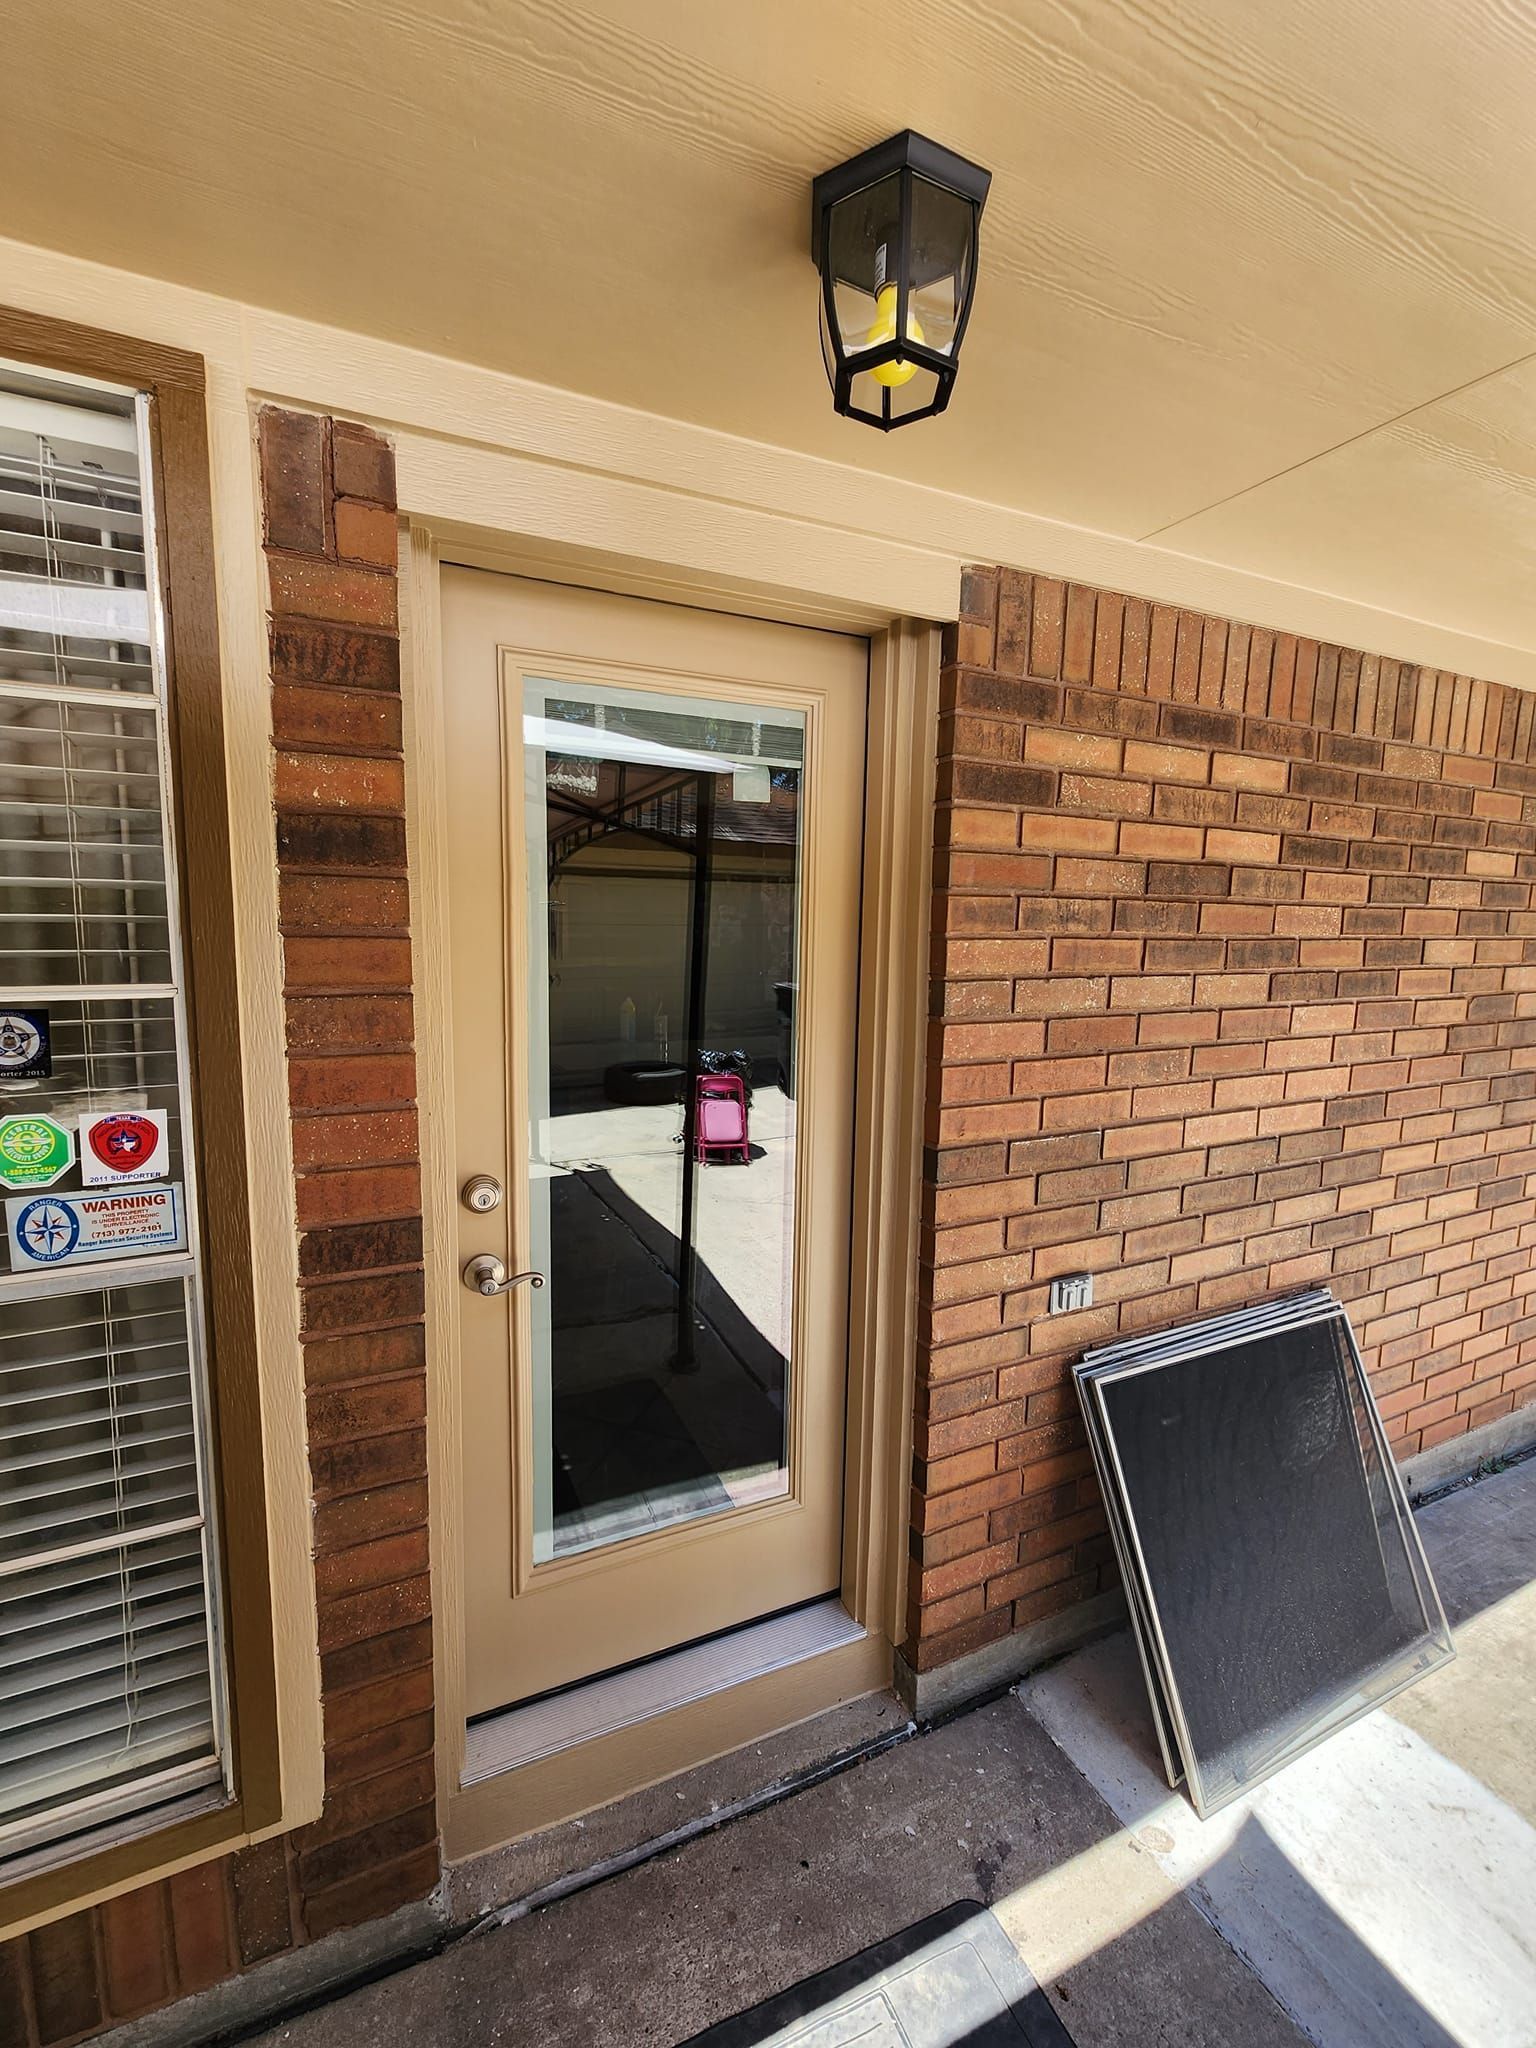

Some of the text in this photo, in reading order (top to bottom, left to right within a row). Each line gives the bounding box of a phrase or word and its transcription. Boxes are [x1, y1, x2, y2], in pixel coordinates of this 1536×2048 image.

[5, 1124, 48, 1140] CENTRAL
[89, 1171, 161, 1183] 2011 SUPPORTER
[28, 1199, 63, 1211] RANGER
[81, 1193, 166, 1214] WARNING
[117, 1208, 149, 1217] PROPERTY
[122, 1212, 160, 1221] ELECTRONIC
[103, 1218, 149, 1228] SURVEILLANCE
[78, 1231, 173, 1247] Ranger American Security Systems
[91, 1229, 116, 1239] (713)
[31, 1247, 70, 1261] AMERICAN
